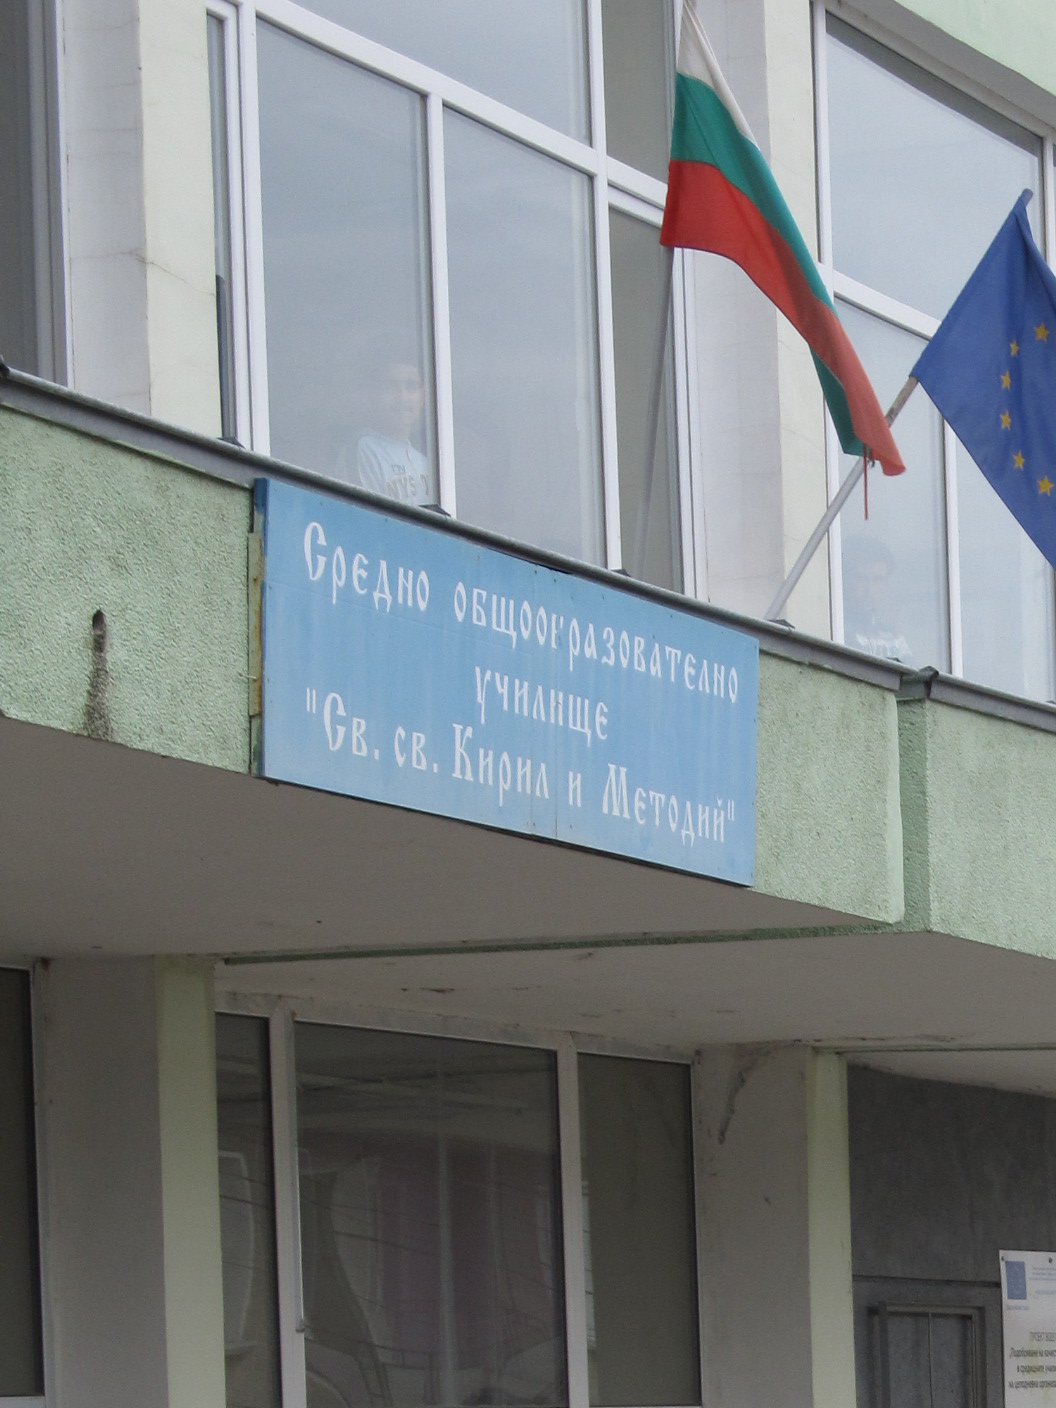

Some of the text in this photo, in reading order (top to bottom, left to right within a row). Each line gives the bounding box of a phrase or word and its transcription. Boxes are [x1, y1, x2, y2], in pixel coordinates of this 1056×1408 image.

[304, 521, 430, 613] Средно
[475, 666, 608, 748] училище
[394, 724, 438, 773] св.
[452, 722, 549, 807] Кирил
[568, 770, 581, 807] и
[602, 763, 735, 848] Методий"
